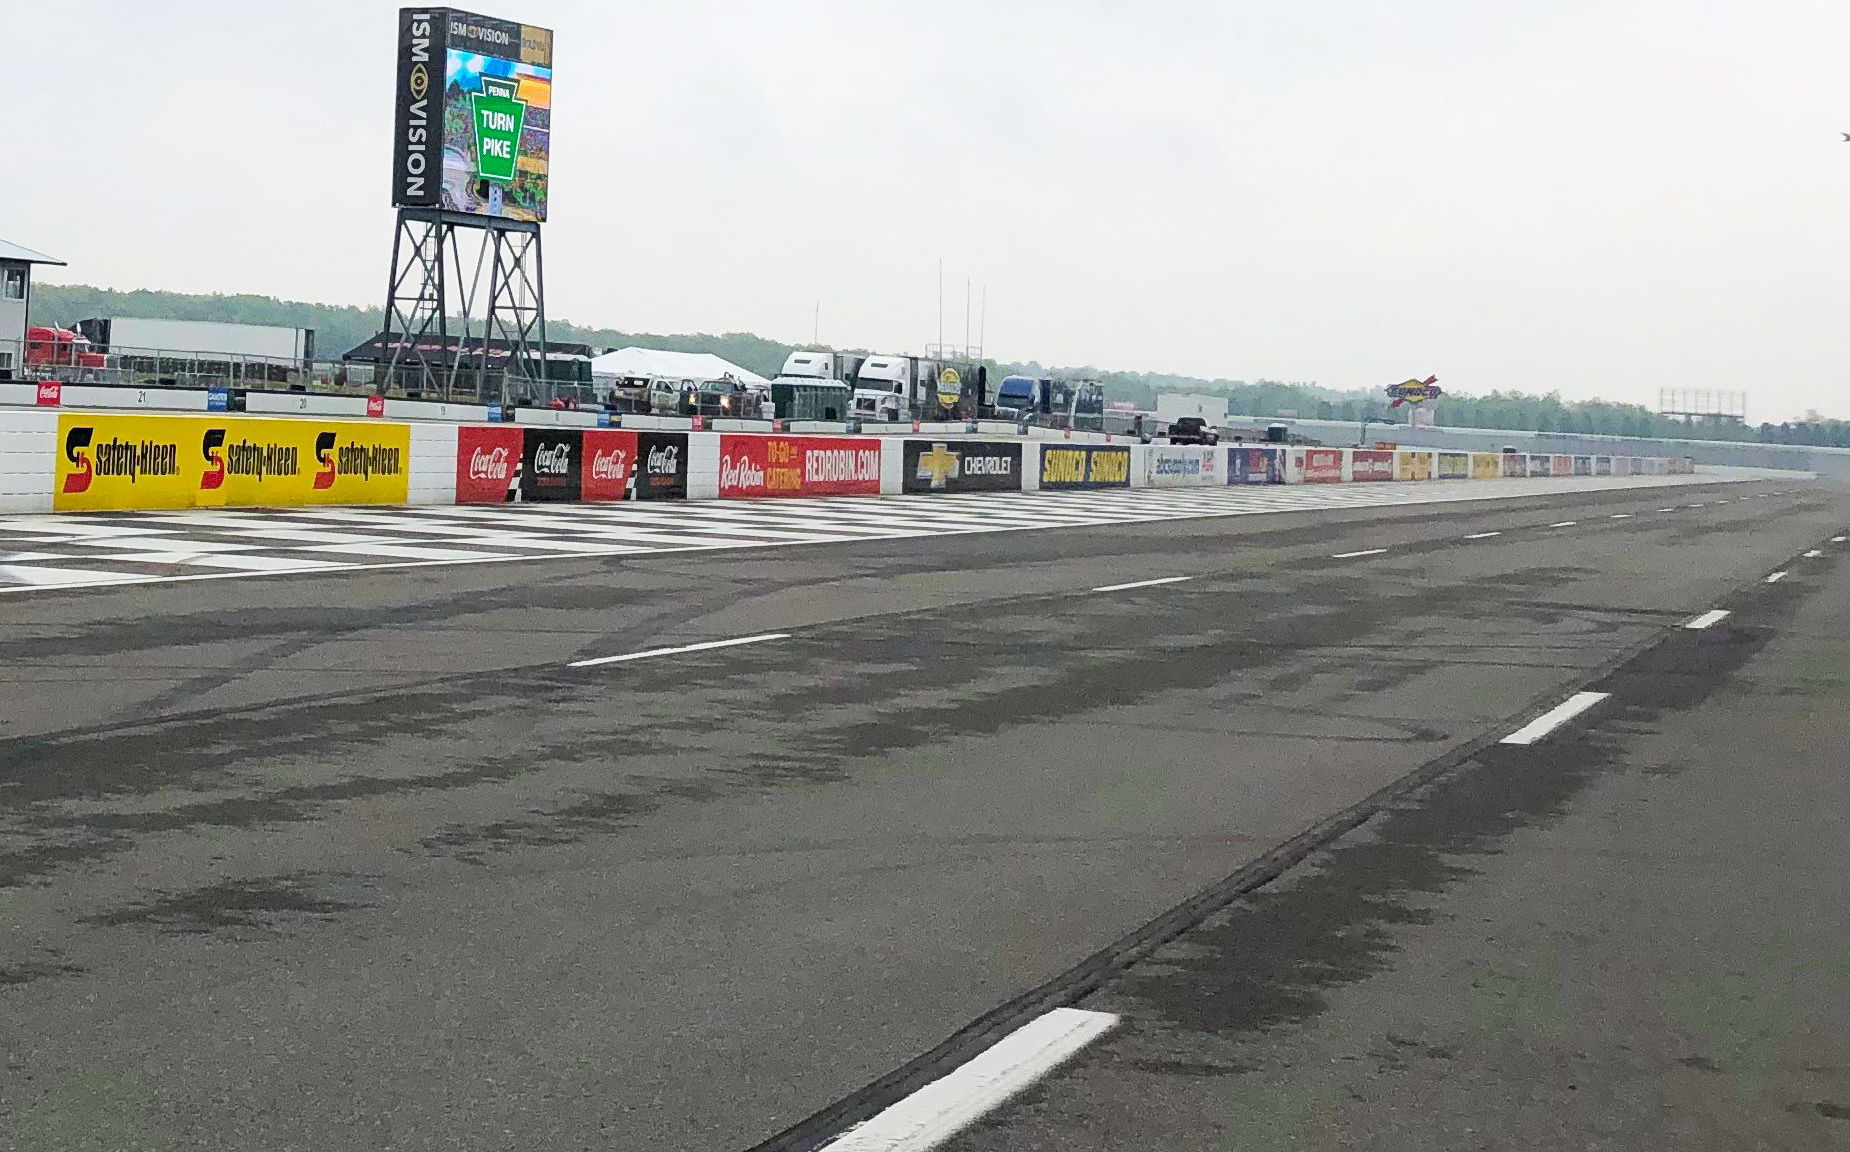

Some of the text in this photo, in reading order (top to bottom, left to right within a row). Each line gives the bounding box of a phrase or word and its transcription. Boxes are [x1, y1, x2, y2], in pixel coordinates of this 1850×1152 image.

[450, 21, 467, 37] ISM
[478, 27, 509, 45] VISION
[406, 13, 431, 196] ISM VISION
[481, 109, 515, 132] TURN
[482, 137, 511, 159] PIKE
[138, 390, 147, 403] 21
[720, 454, 765, 490] Red Robin
[805, 449, 879, 482] REDROBIN.COM
[964, 456, 1011, 475] CHEVROLET
